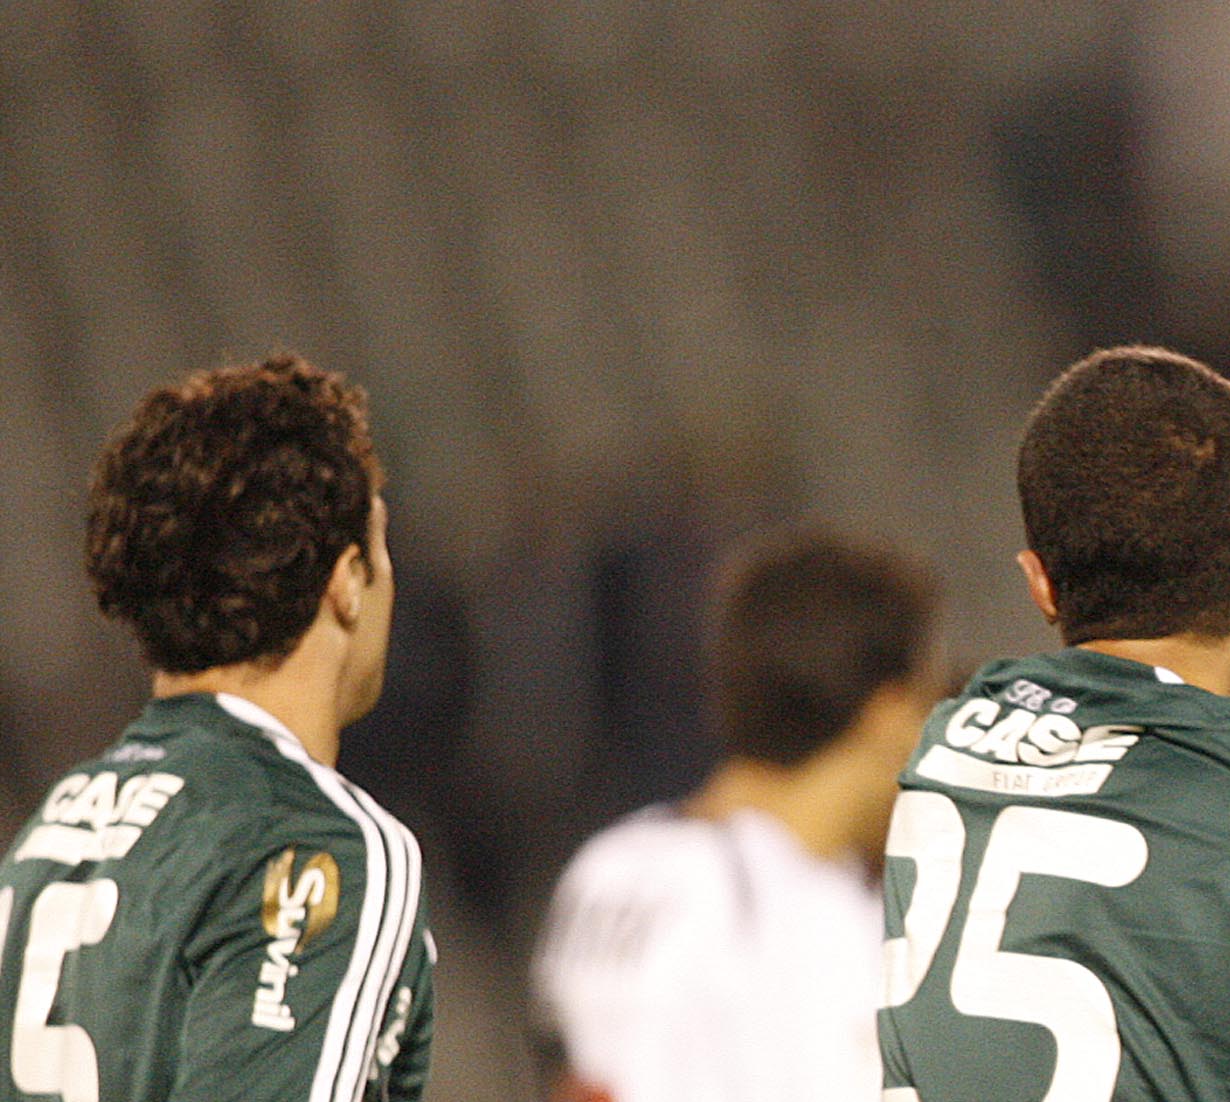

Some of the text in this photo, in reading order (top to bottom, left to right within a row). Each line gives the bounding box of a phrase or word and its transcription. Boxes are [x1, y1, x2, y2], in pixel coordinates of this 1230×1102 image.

[946, 698, 1146, 766] CASE
[992, 771, 1032, 792] FIAT
[252, 868, 326, 1032] Suvinil
